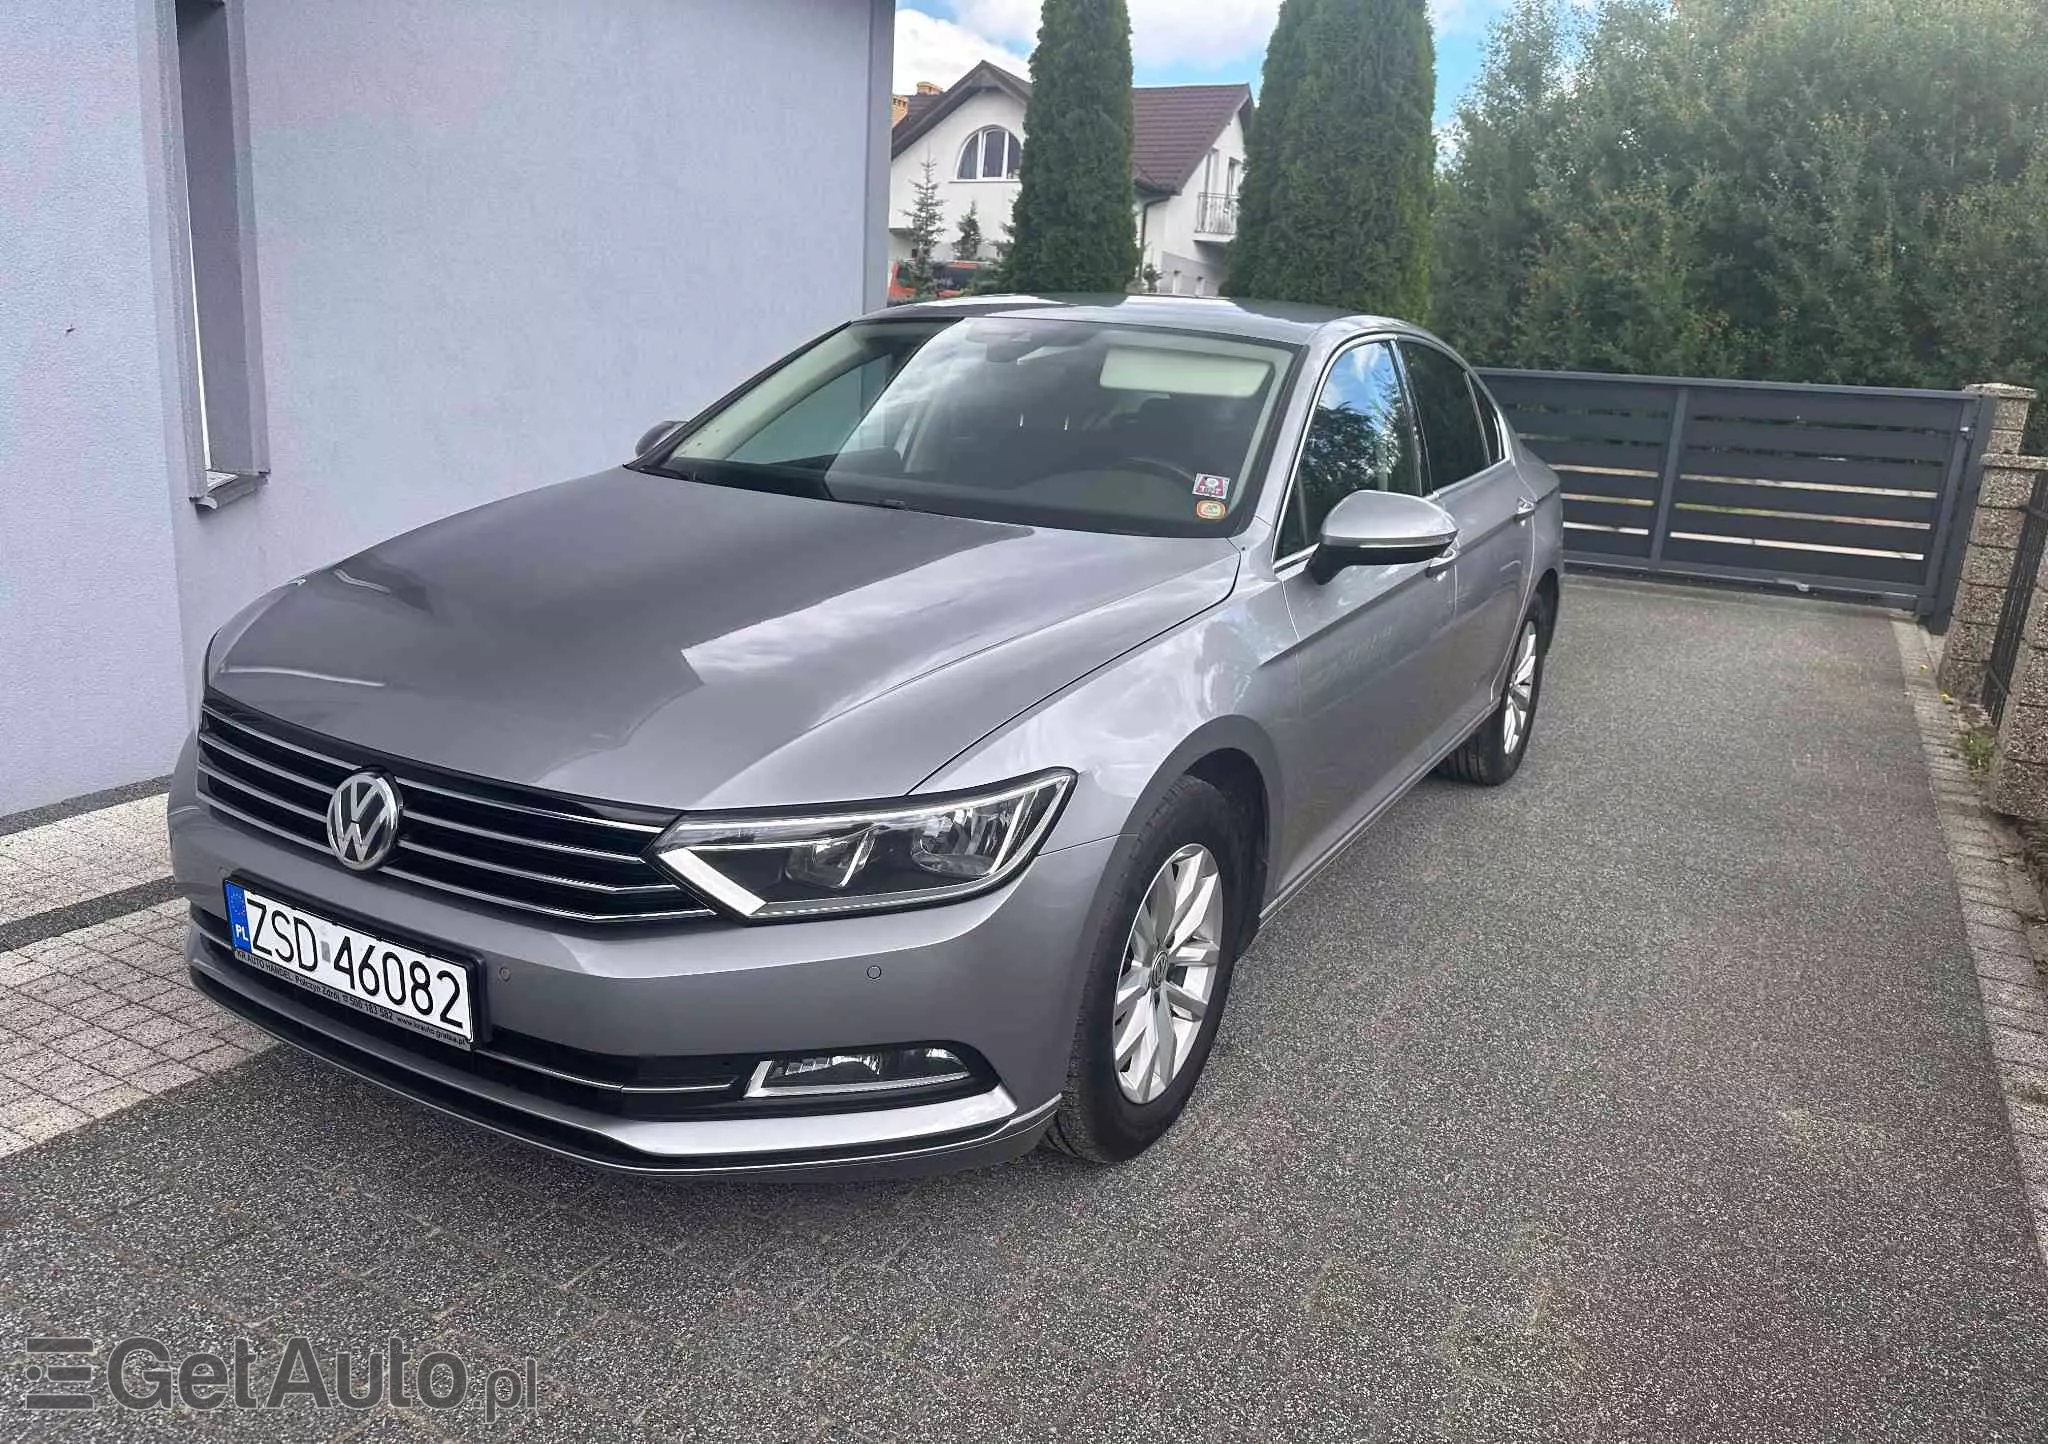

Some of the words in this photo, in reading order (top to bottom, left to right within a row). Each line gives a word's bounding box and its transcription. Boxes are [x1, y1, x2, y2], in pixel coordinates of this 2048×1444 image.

[328, 773, 398, 870] VW
[235, 923, 248, 941] PL
[247, 899, 319, 972] ZSD
[333, 936, 463, 1028] 46082
